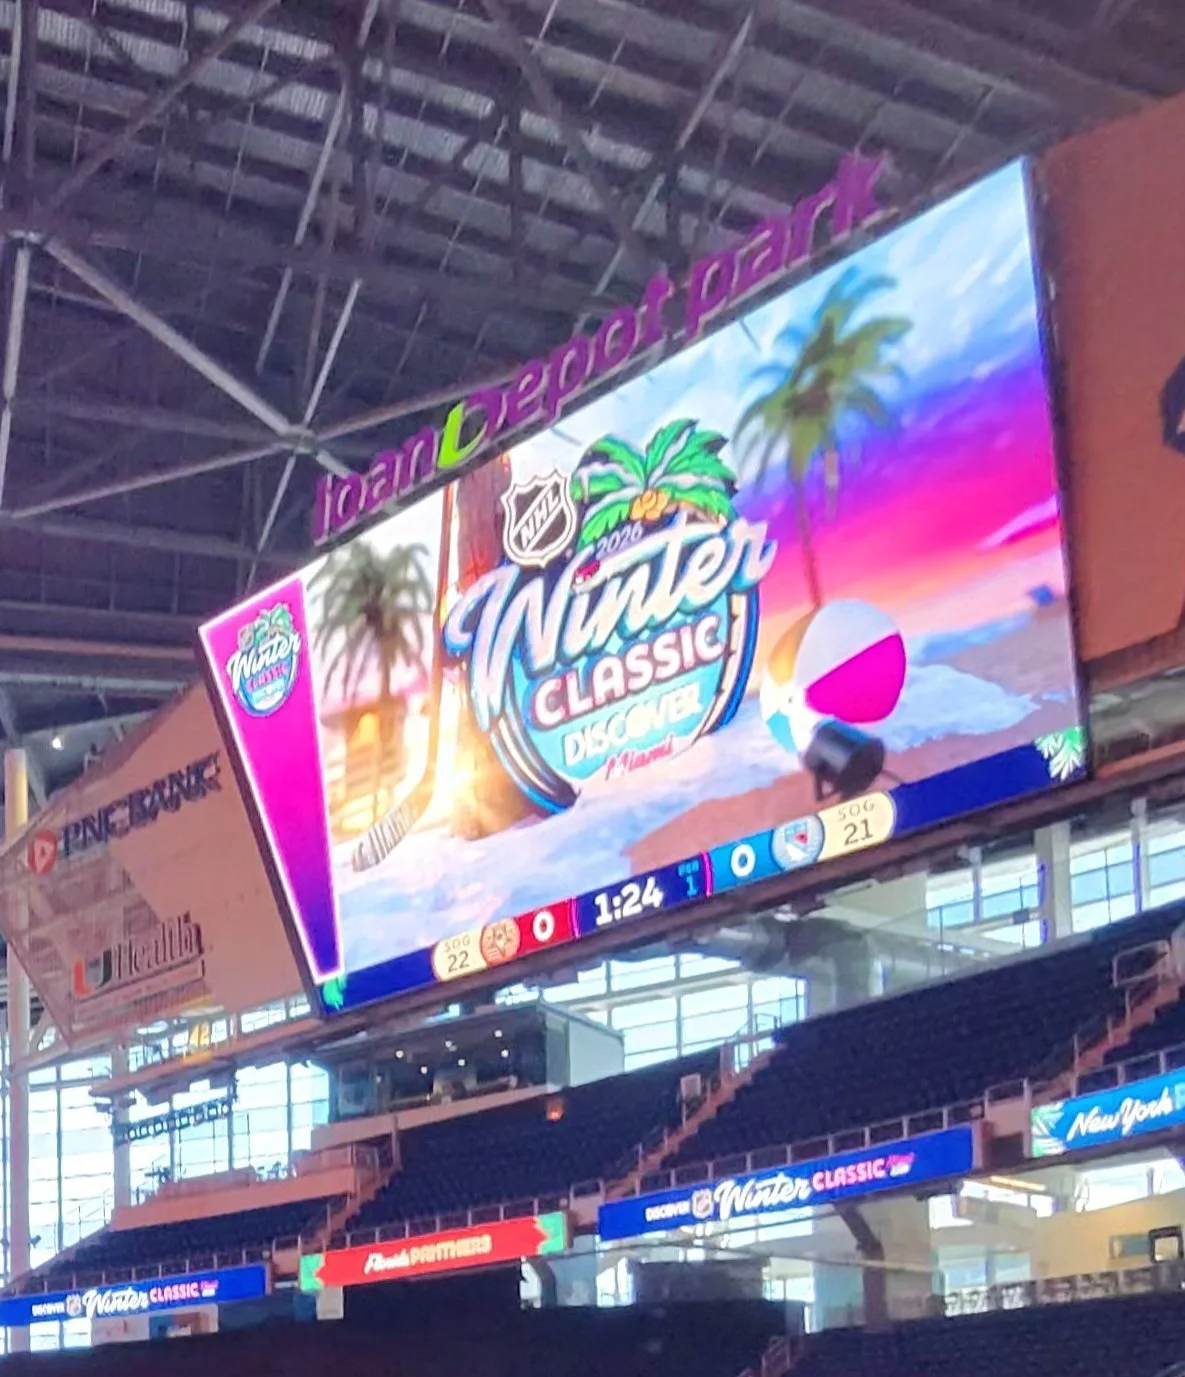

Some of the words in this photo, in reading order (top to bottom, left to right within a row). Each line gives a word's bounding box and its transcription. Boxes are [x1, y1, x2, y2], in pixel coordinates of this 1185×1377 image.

[312, 270, 674, 546] loanDepot
[685, 150, 894, 344] park
[519, 488, 561, 549] NHL
[596, 521, 644, 557] 2026
[445, 511, 777, 732] Winter
[227, 632, 301, 693] Winter
[532, 614, 725, 731] CLASSIC
[562, 685, 701, 766] DISCOVER
[838, 799, 875, 821] SOG
[844, 819, 873, 846] 21
[731, 844, 756, 877] 0
[594, 877, 664, 926] 1:24
[685, 875, 697, 897] 1
[443, 935, 471, 953] SOG
[532, 910, 555, 942] 0
[447, 951, 469, 973] 22
[1067, 1106, 1120, 1142] New
[1120, 1086, 1173, 1136] York
[715, 1171, 811, 1220] Winter
[812, 1158, 886, 1191] CLASSIC
[410, 1234, 492, 1266] PANTHERS
[83, 1286, 149, 1317] Winter
[149, 1282, 199, 1303] CLASSIC
